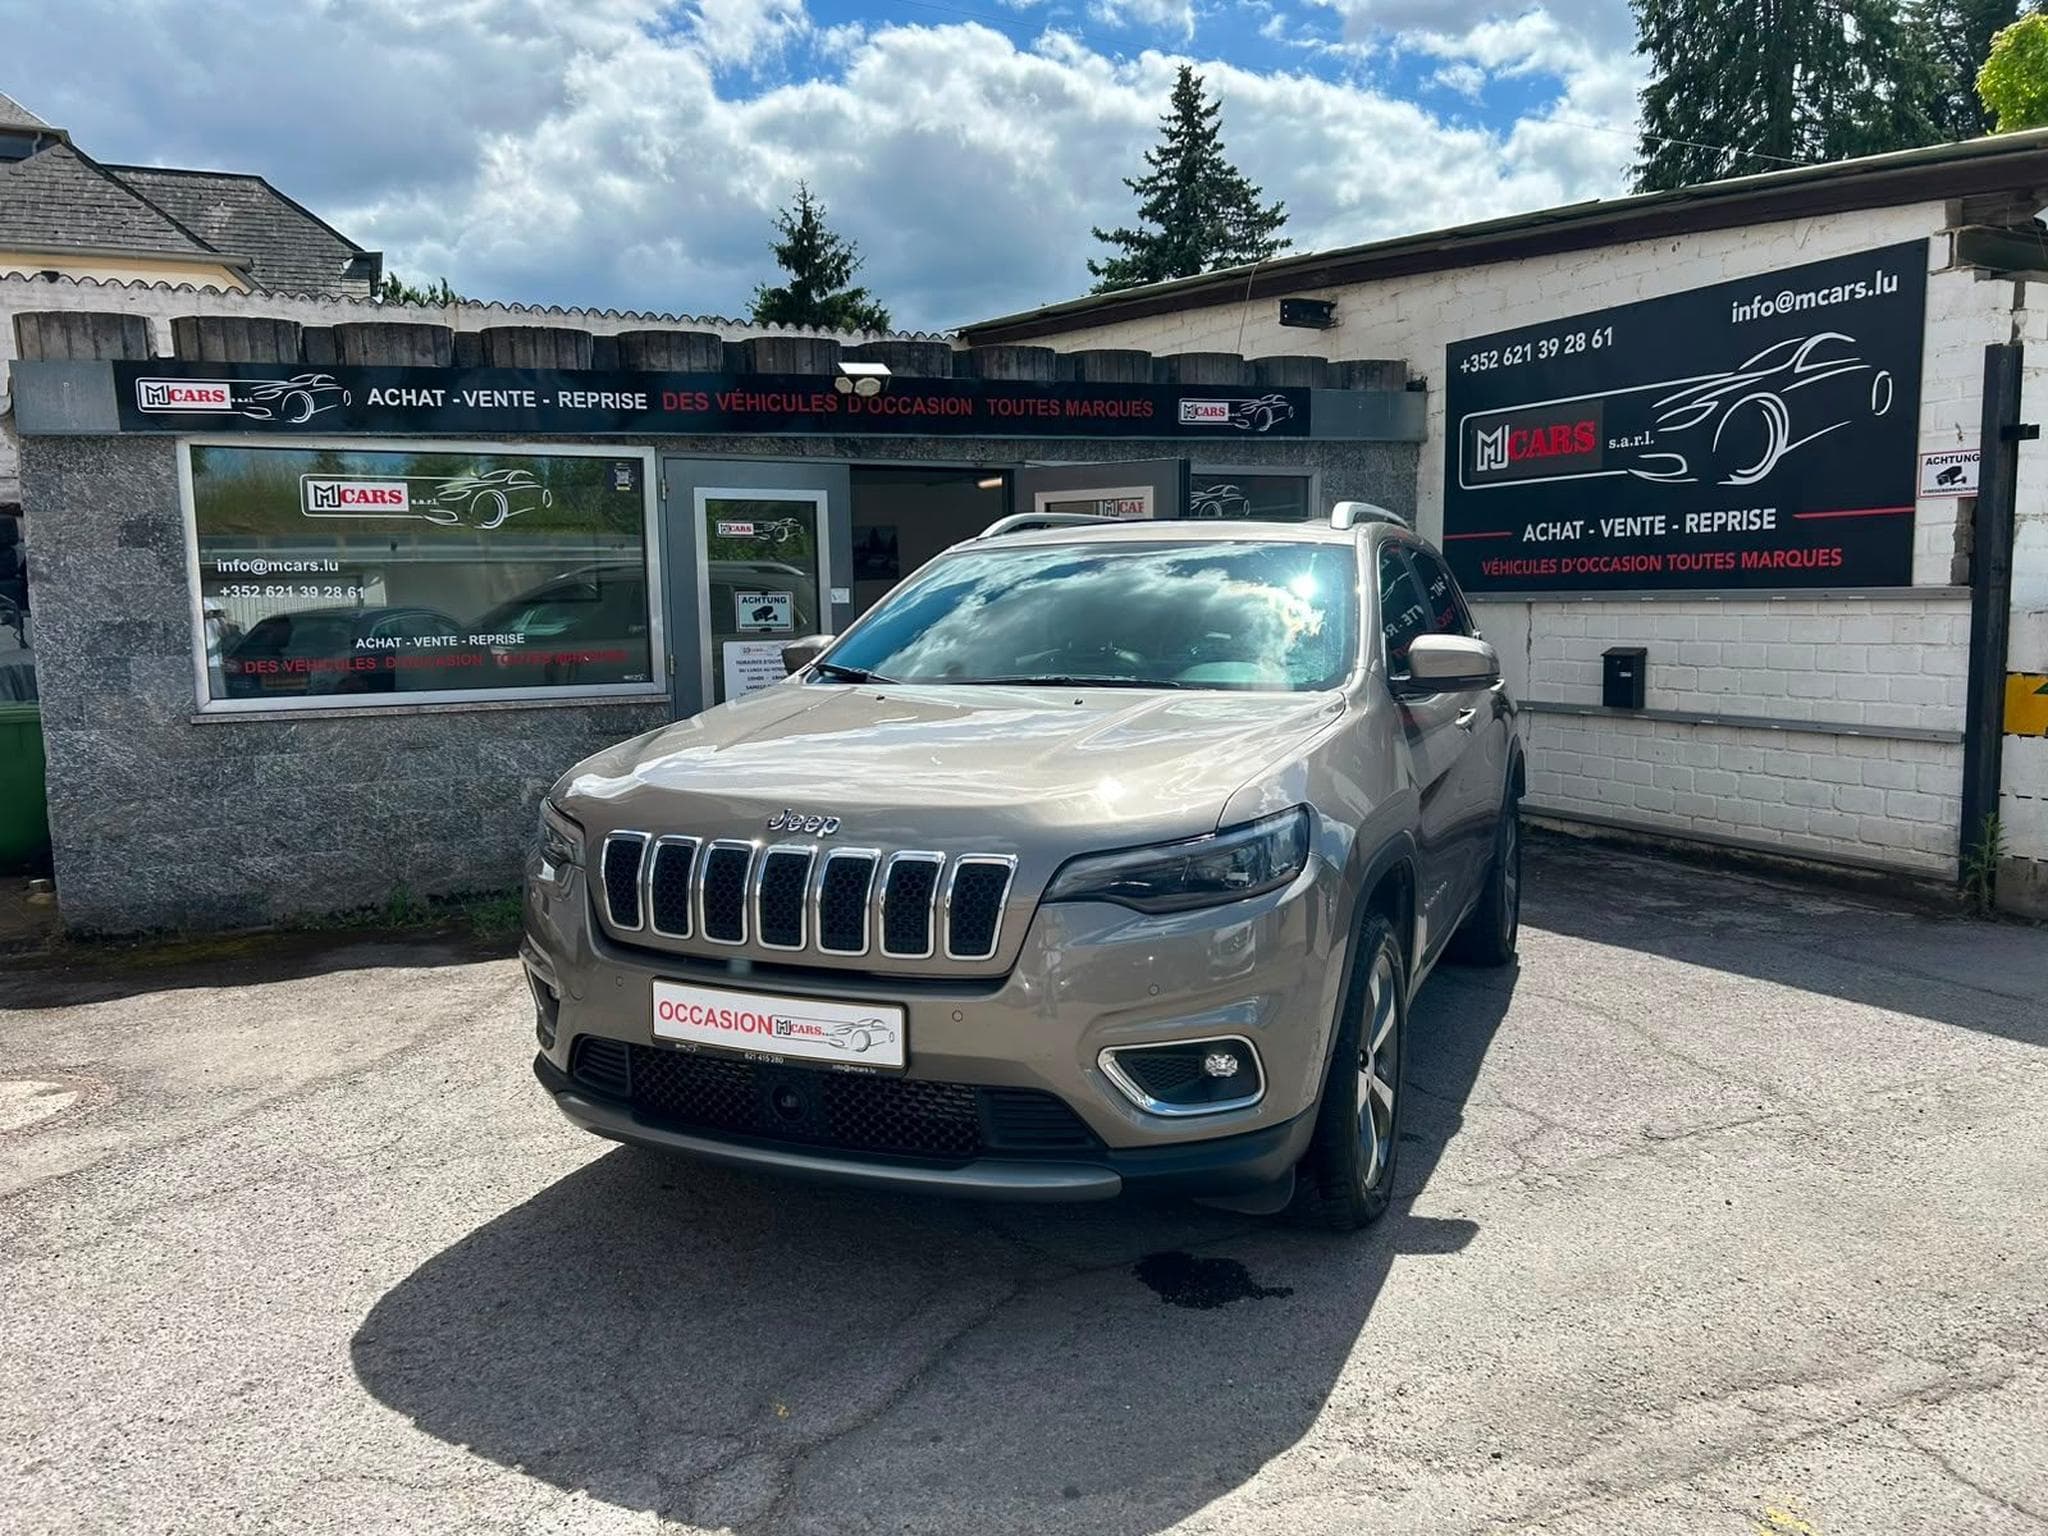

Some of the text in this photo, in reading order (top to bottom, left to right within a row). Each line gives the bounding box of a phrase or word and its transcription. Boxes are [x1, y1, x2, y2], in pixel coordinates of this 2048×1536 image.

[1732, 270, 1897, 323] info@mcars.lu
[1460, 326, 1613, 373] +352 621 39 28 61
[367, 388, 445, 406] ACHAT
[463, 390, 536, 407] VENTE
[558, 391, 648, 410] REPRISE
[662, 388, 1153, 418] DES VÉHICULES D'OCCASION TOUTES MARQUES
[1608, 431, 1654, 449] s.a.r.l.
[1926, 453, 1980, 466] ACHTUNG
[1523, 521, 1584, 541] ACHAT
[1600, 515, 1666, 538] VENTE
[1685, 508, 1776, 533] REPRISE
[217, 558, 339, 575] info@mcars.lu
[1482, 557, 1557, 575] VÉHICULES
[1667, 552, 1735, 571] TOUTES
[1741, 548, 1843, 569] MARQUES
[220, 585, 365, 599] +352 621 39 28 61
[741, 596, 787, 604] ACHTUNG
[356, 637, 402, 649] ACHAT
[413, 635, 457, 648] VENTE
[469, 633, 525, 646] REPRISE
[245, 660, 278, 673] DES
[768, 808, 841, 838] Jeep
[659, 1001, 772, 1035] OCCASION
